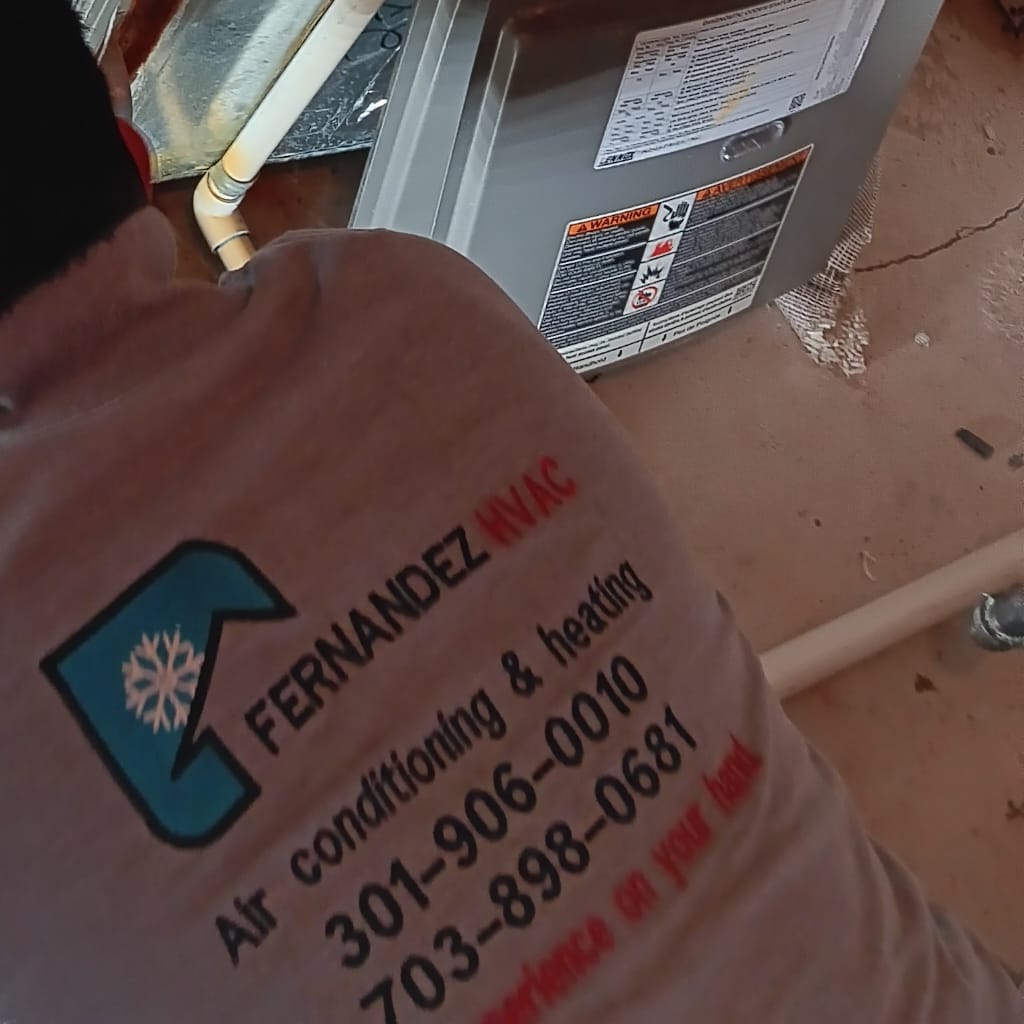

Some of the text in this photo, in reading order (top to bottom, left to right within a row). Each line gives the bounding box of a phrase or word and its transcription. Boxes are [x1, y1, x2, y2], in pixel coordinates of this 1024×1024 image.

[589, 207, 652, 230] WARNING
[213, 556, 653, 966] Air conditioning & heating
[245, 455, 580, 756] FERNANDEZ HVAC
[324, 654, 650, 970] 301-906-0010
[359, 705, 700, 1024] 703-898-0681
